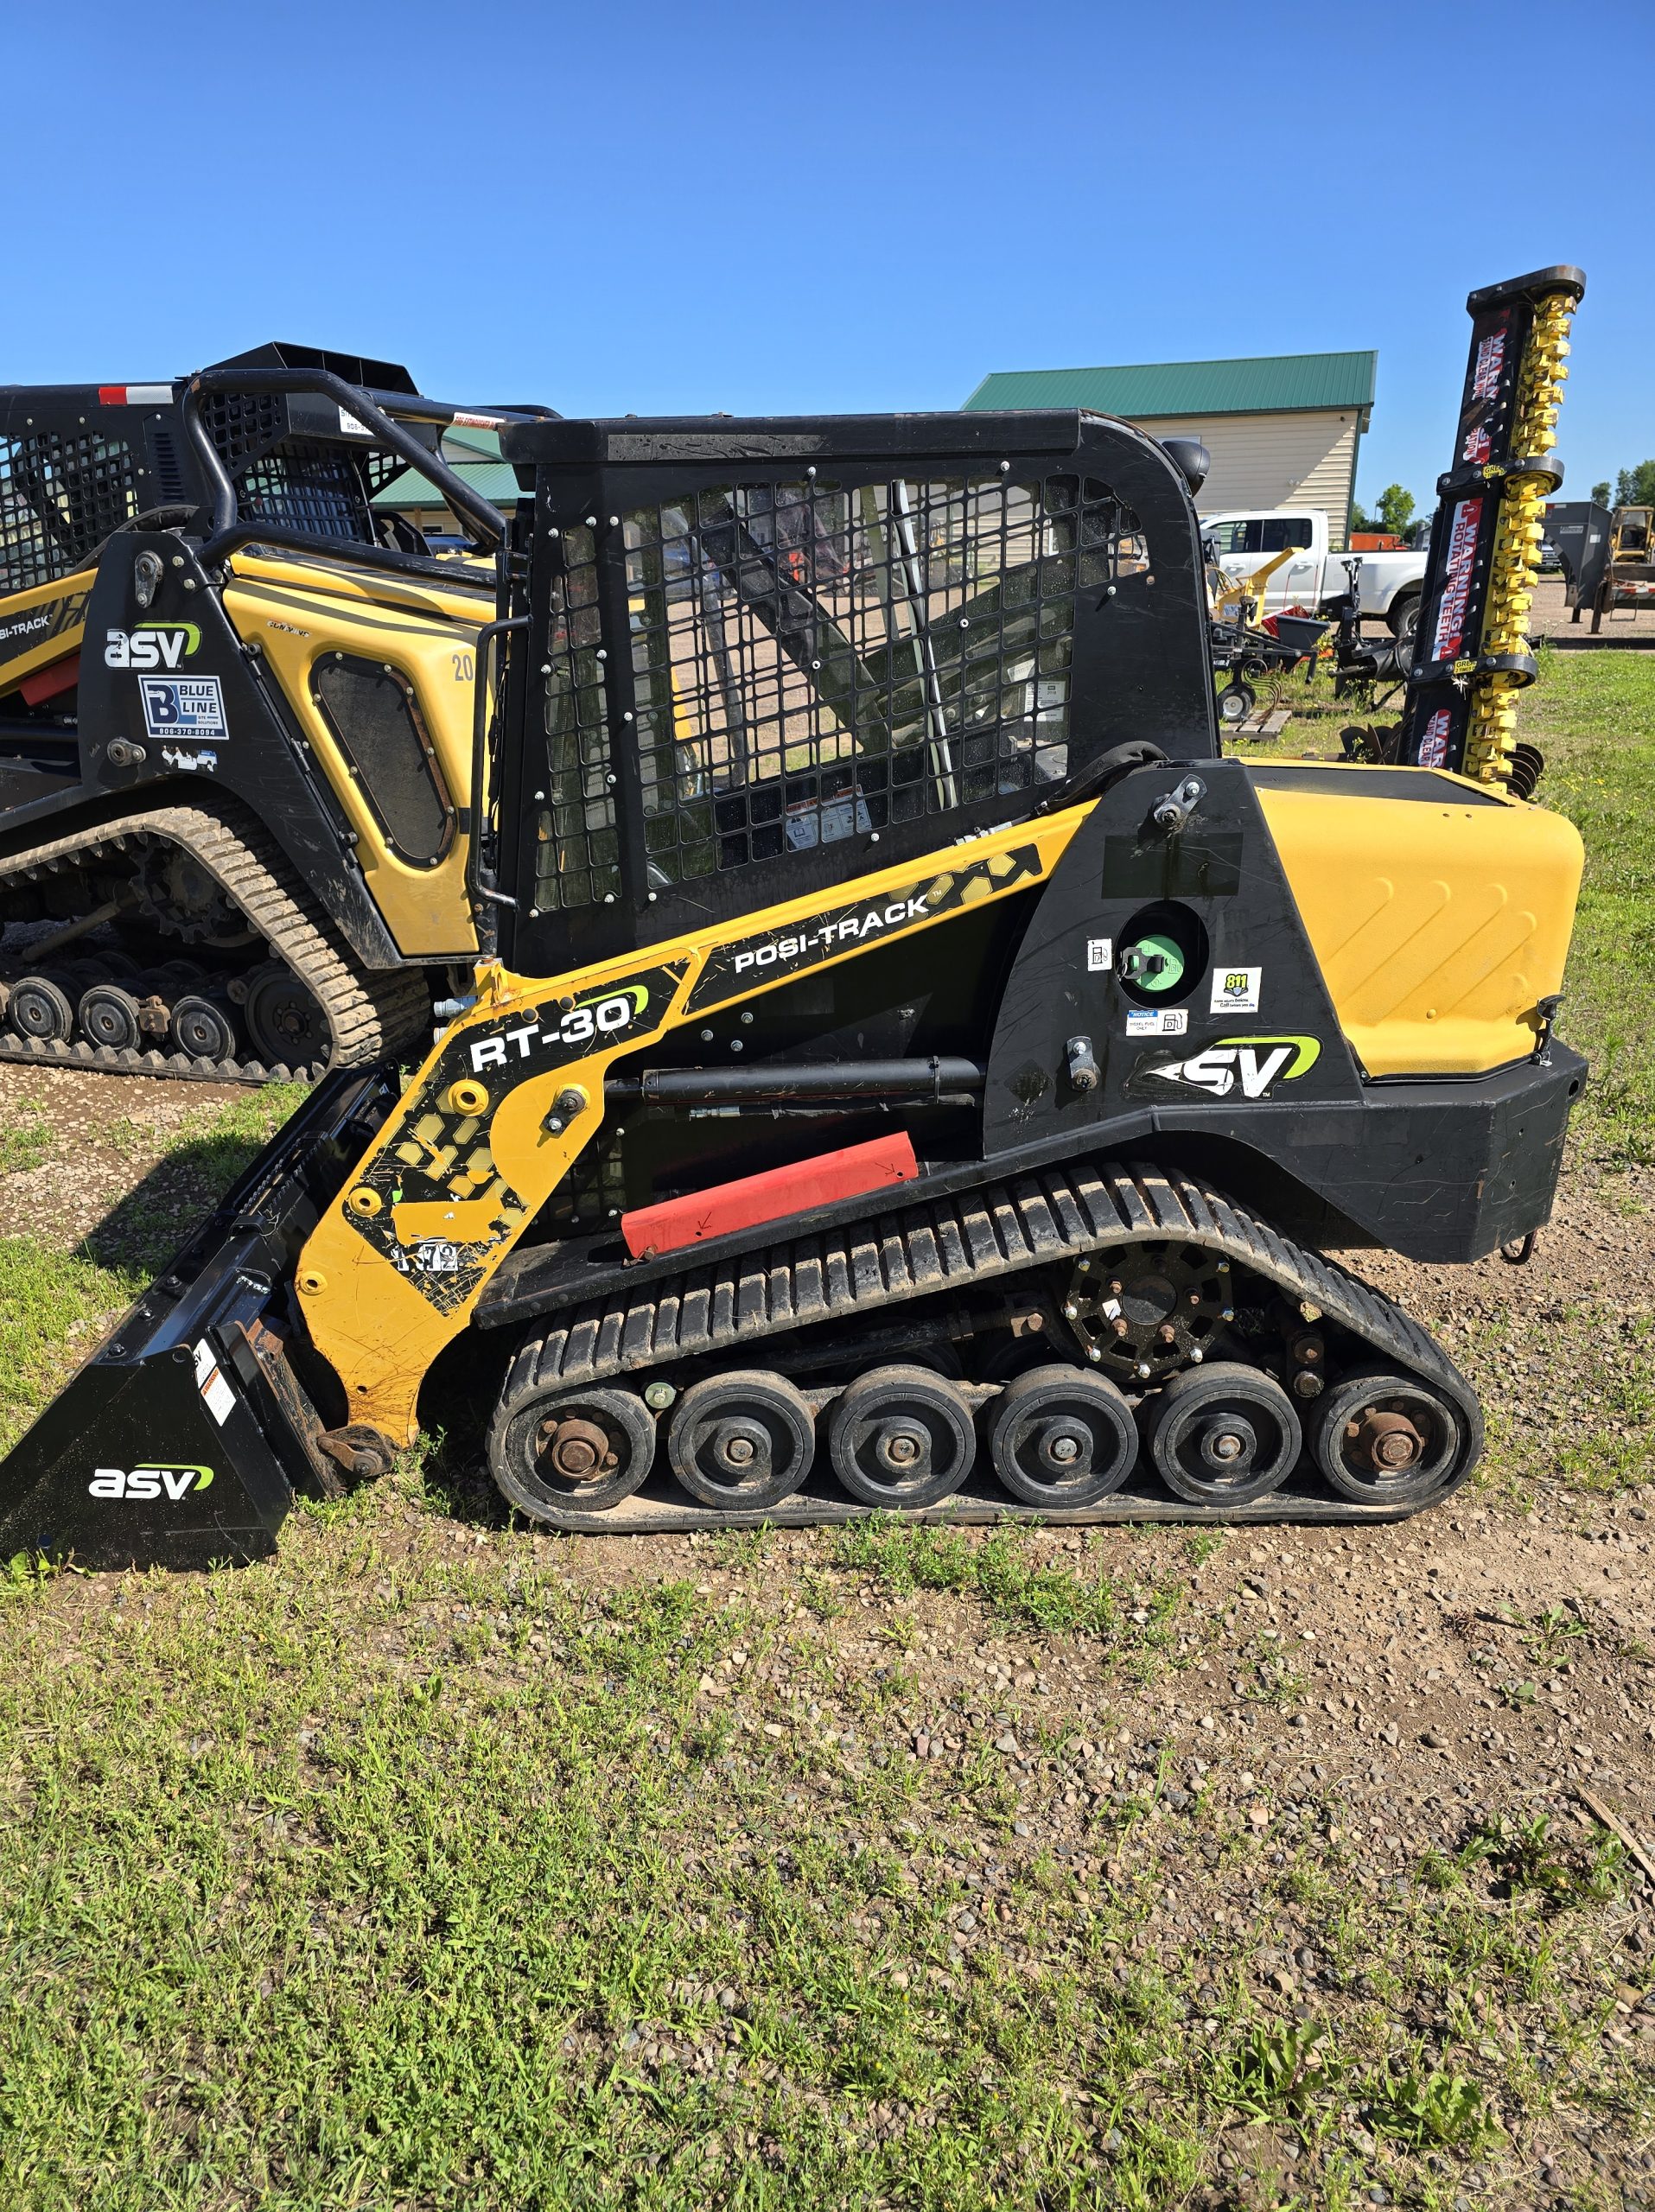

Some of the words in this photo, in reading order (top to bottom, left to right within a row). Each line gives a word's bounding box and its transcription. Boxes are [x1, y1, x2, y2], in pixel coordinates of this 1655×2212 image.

[1477, 359, 1489, 382] CLEAR
[1479, 334, 1505, 449] WARNG!
[1449, 522, 1478, 639] WARNING!
[0, 615, 50, 639] SI-TRACK
[1438, 598, 1454, 643] TEETH
[452, 654, 474, 681] 20
[179, 684, 214, 696] BLUE
[182, 702, 217, 714] LINE
[1431, 714, 1450, 767] WAR
[735, 893, 930, 974] POSI-TRACK
[1225, 973, 1248, 989] 811
[469, 997, 630, 1073] RT-30
